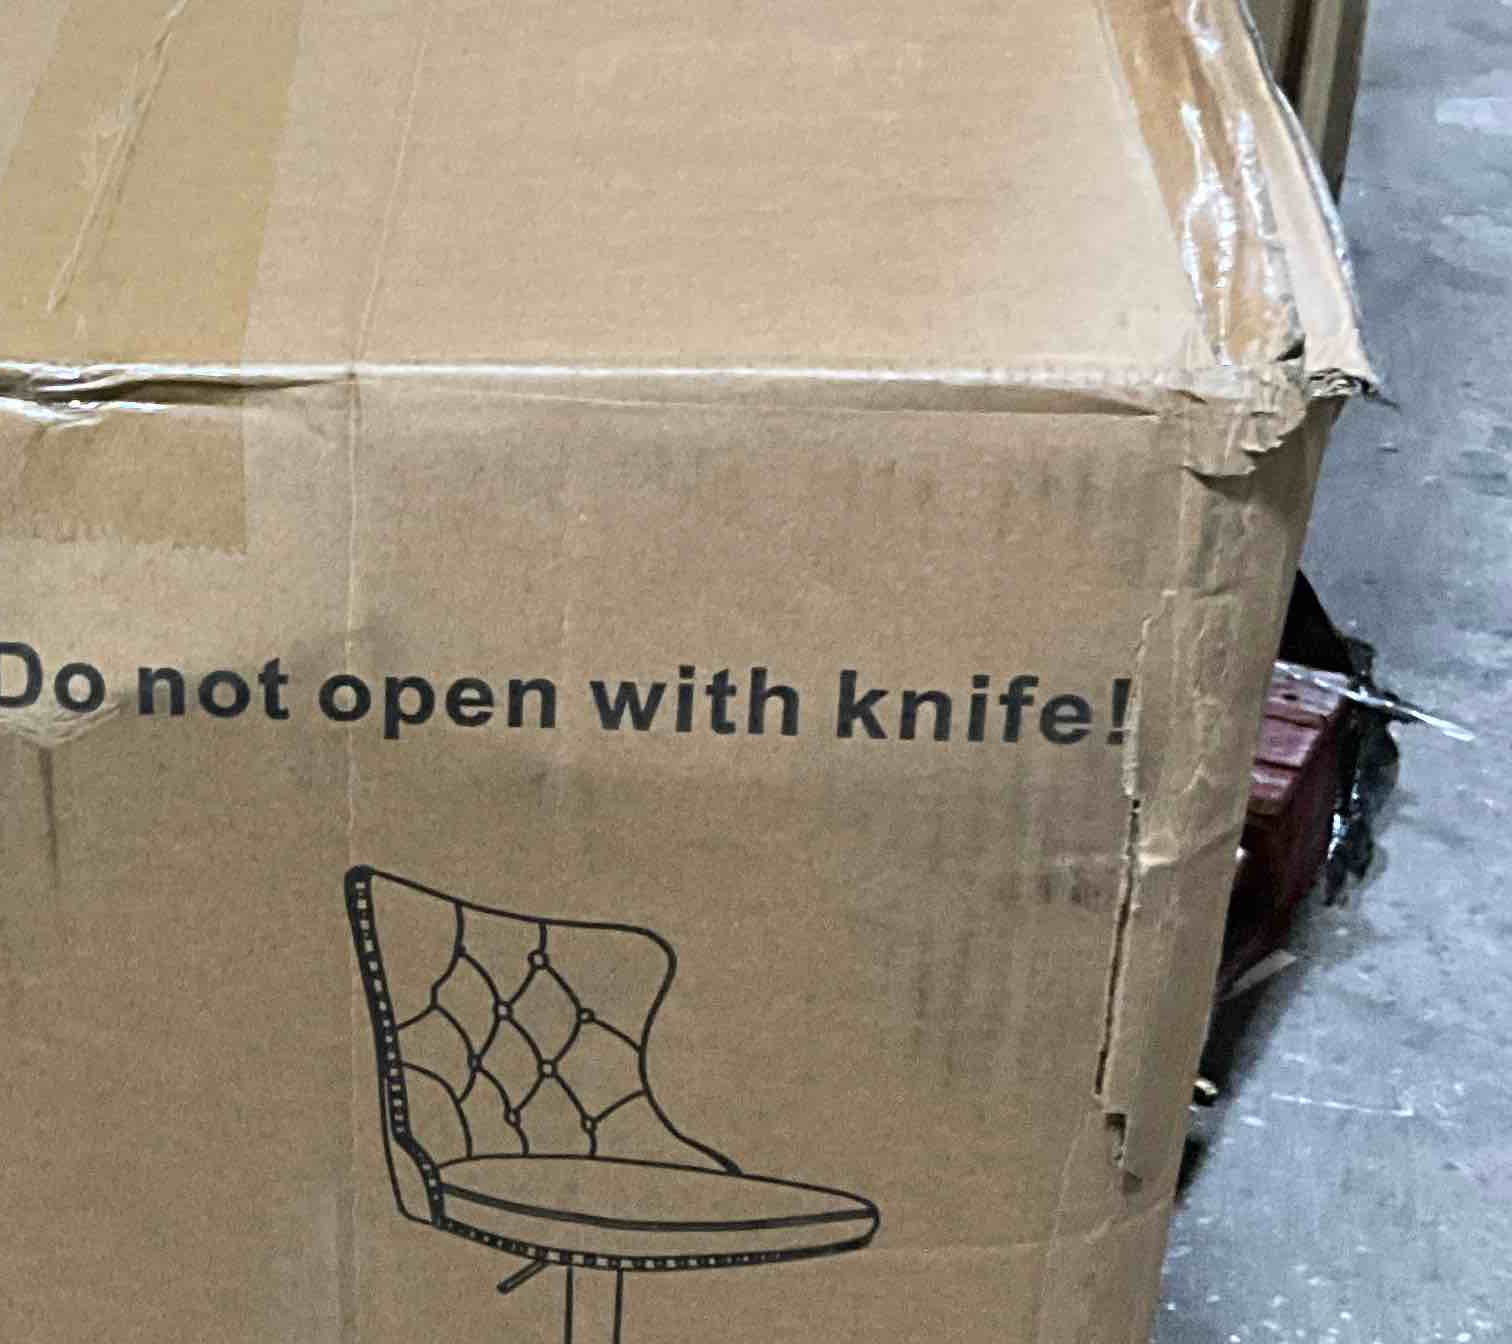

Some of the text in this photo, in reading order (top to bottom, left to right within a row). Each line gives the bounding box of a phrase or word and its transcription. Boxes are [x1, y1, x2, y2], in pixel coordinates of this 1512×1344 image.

[138, 657, 289, 720] not
[318, 673, 557, 740] open
[589, 664, 800, 736] with
[836, 669, 1132, 745] knife!
